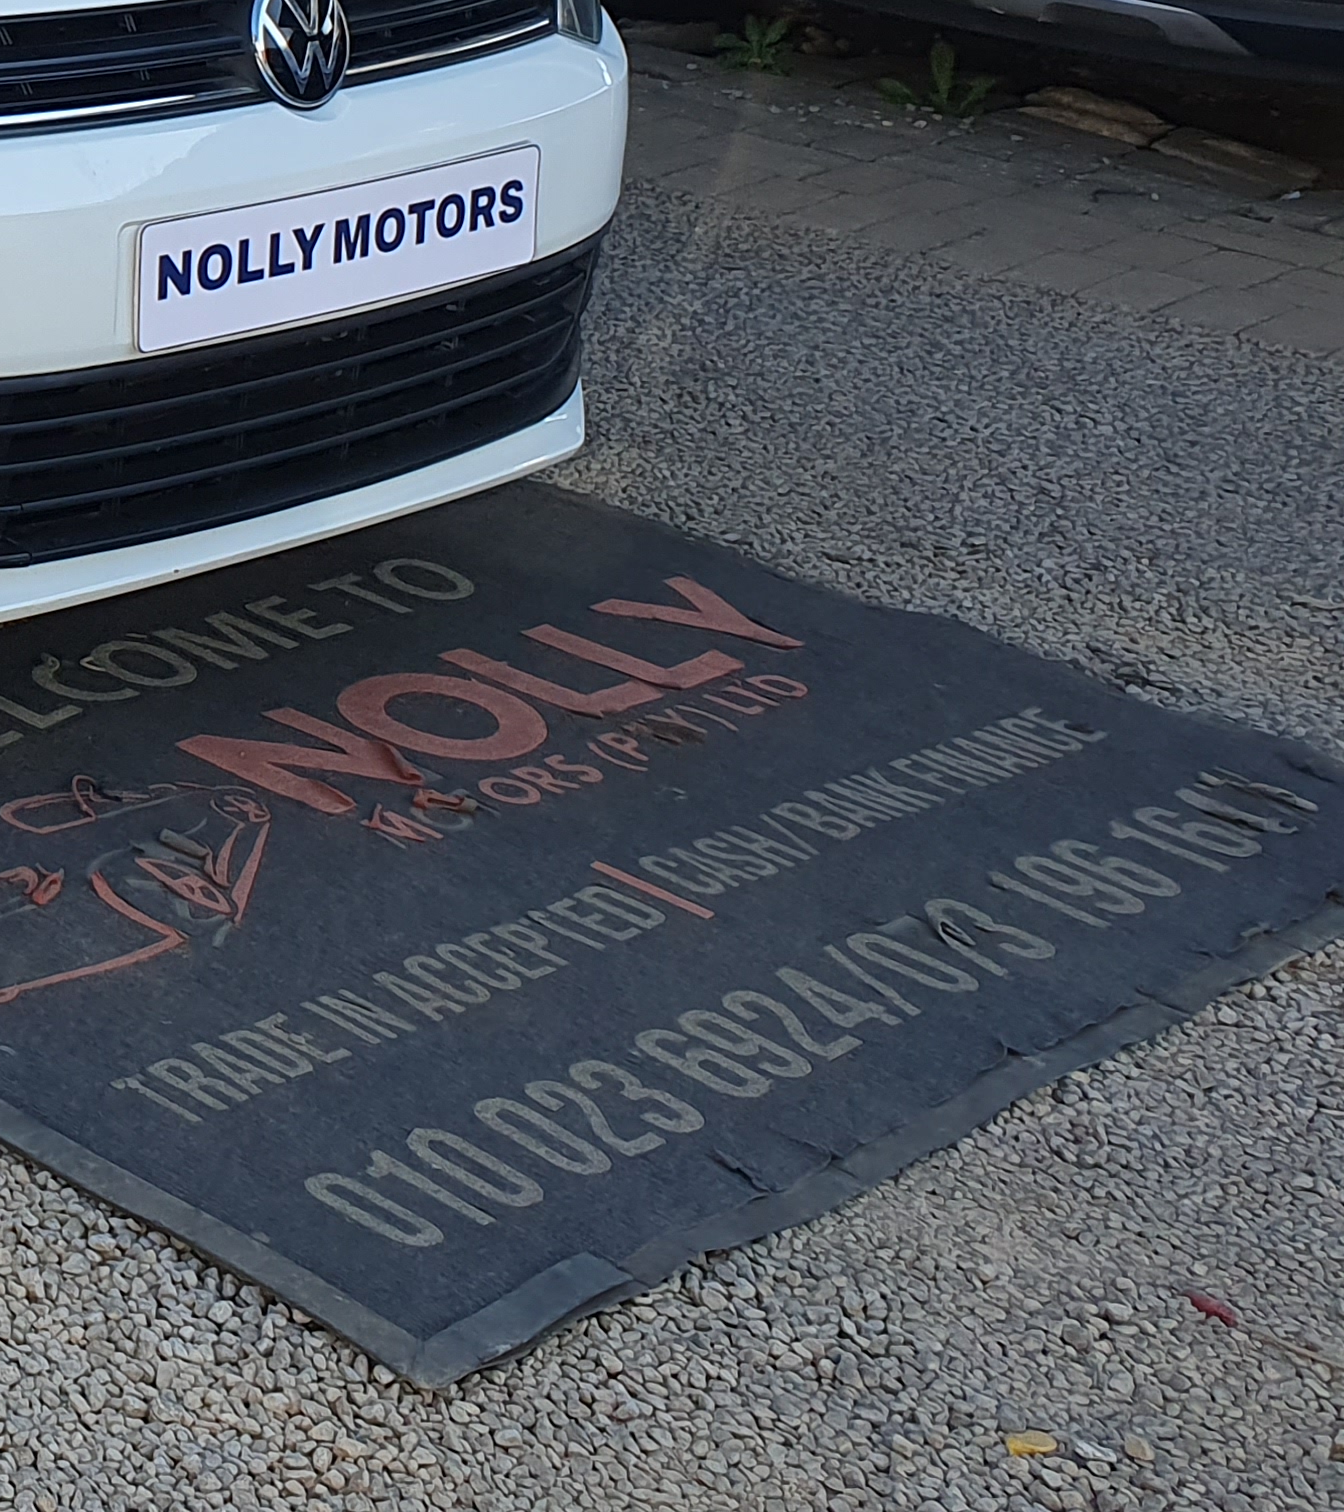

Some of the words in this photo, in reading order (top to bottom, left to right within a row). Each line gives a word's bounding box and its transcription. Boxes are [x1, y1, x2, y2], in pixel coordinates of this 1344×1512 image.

[157, 223, 326, 301] NOLLY
[333, 180, 524, 264] MOTORS
[176, 575, 804, 814] NOLLY
[307, 558, 474, 613] TO
[111, 1012, 352, 1123] TRADE
[301, 989, 415, 1044] IN
[372, 884, 665, 1021] ACCEPTED
[888, 706, 1108, 794] FINANCE
[304, 1127, 544, 1247] 010
[473, 1059, 704, 1174] 023
[989, 839, 1181, 927] 196
